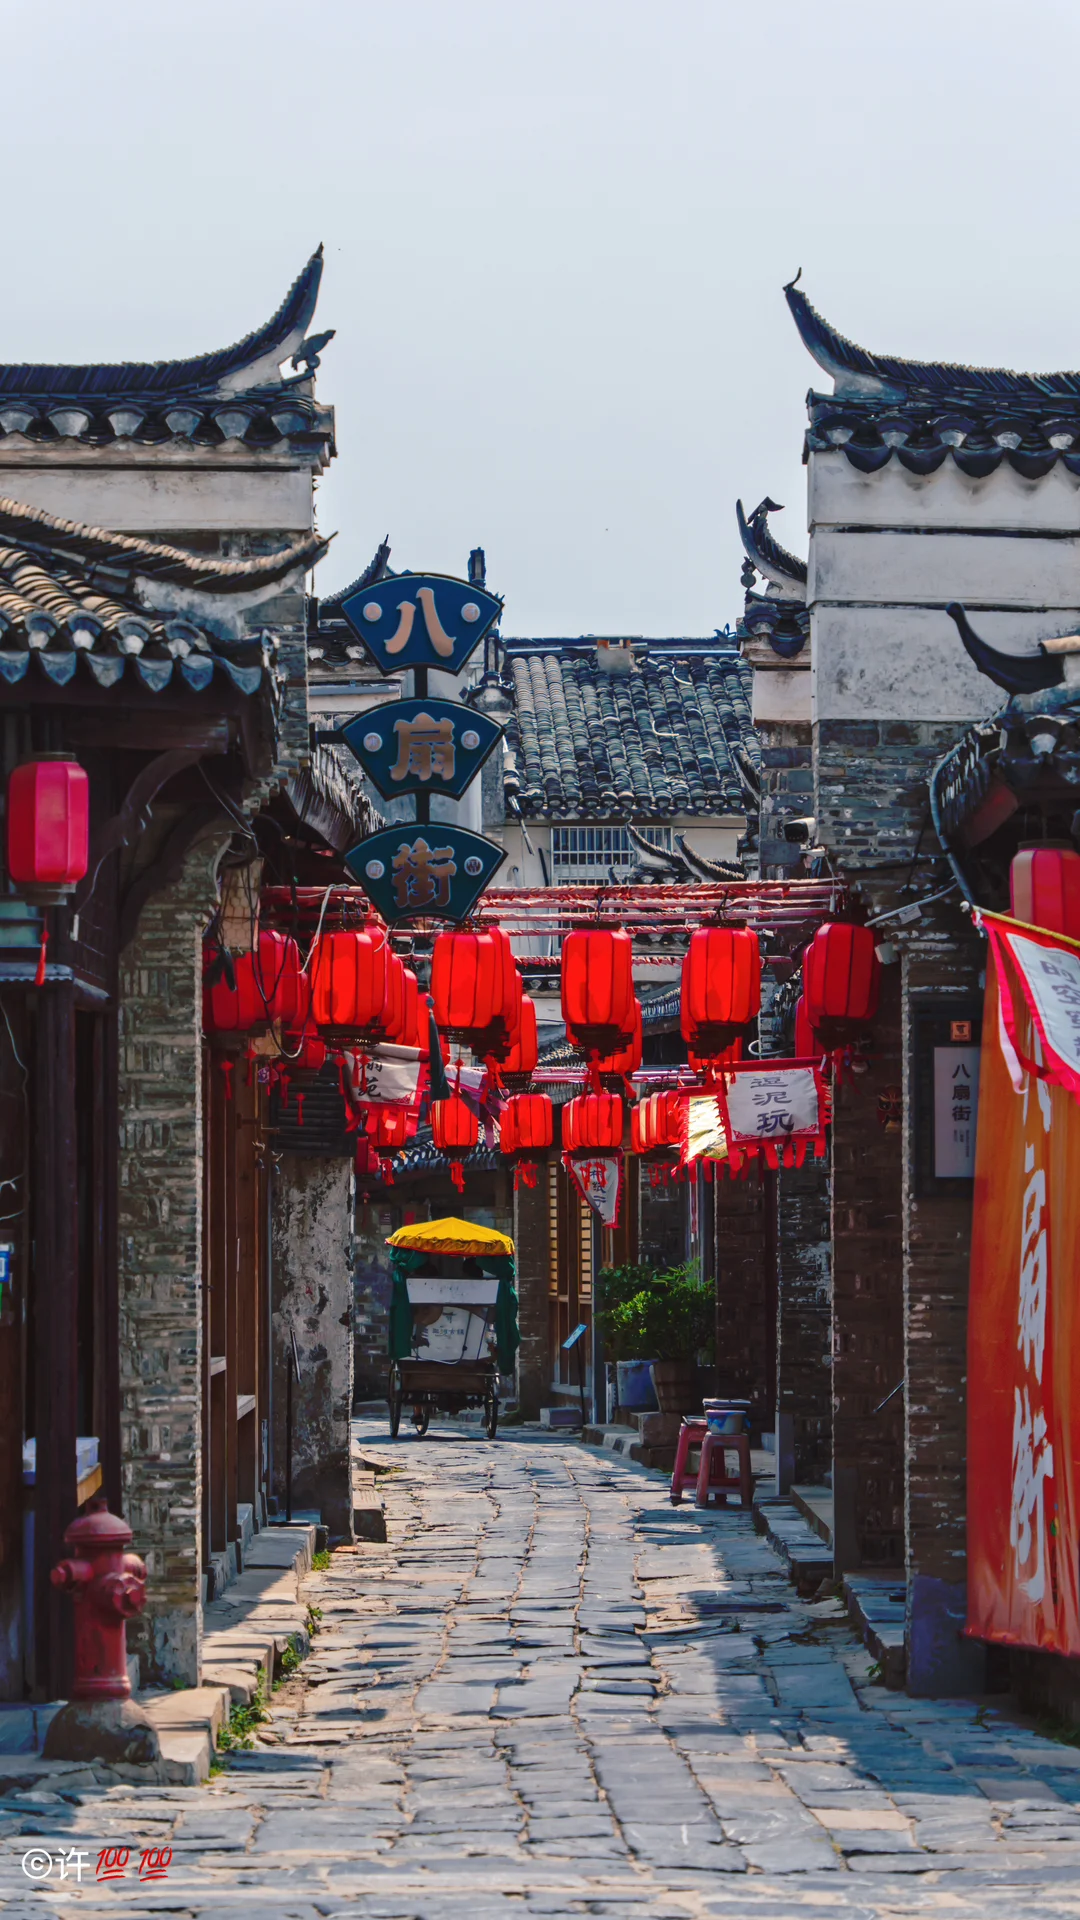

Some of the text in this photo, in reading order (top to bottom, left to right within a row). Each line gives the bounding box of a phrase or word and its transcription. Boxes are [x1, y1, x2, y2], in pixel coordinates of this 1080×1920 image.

[384, 587, 458, 908] 八扇街
[951, 1063, 972, 1121] 八扇街
